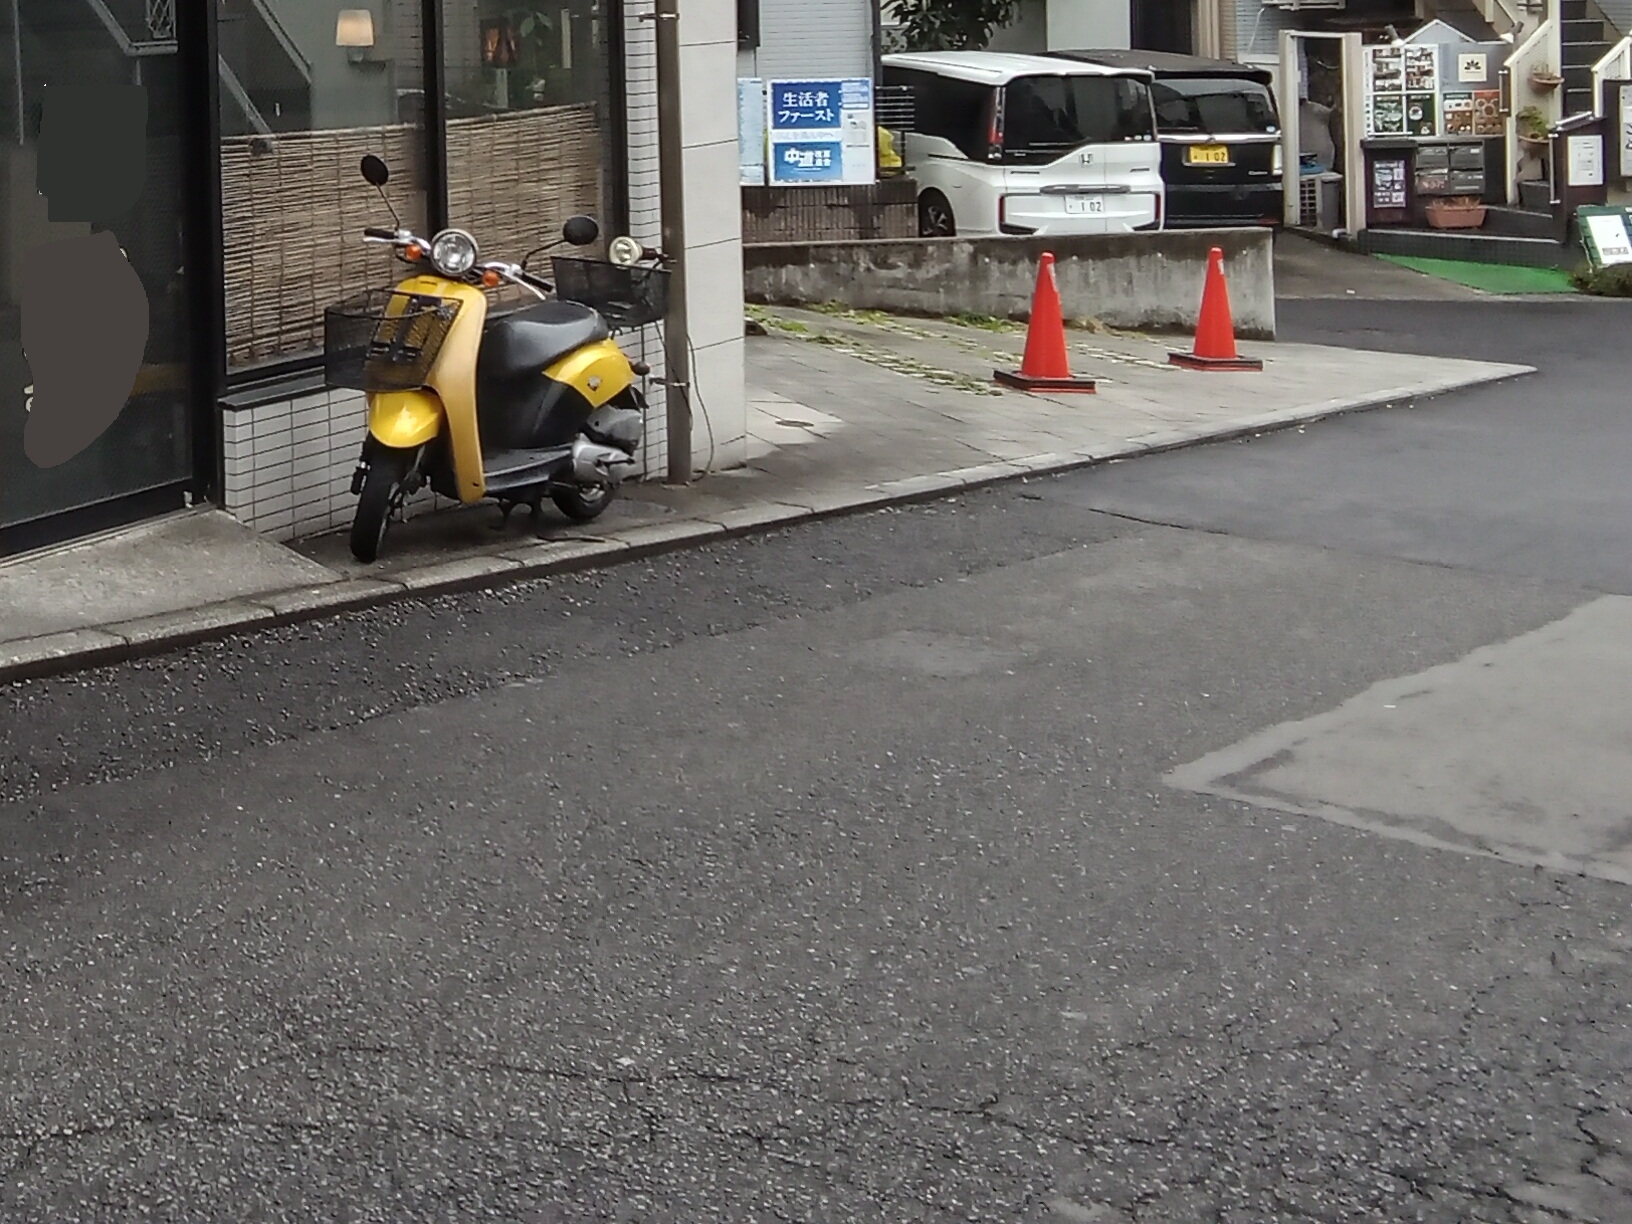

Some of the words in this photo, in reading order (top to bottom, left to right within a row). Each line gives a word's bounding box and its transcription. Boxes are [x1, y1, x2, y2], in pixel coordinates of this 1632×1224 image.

[782, 91, 829, 107] 生活者
[777, 108, 835, 124] ファースト
